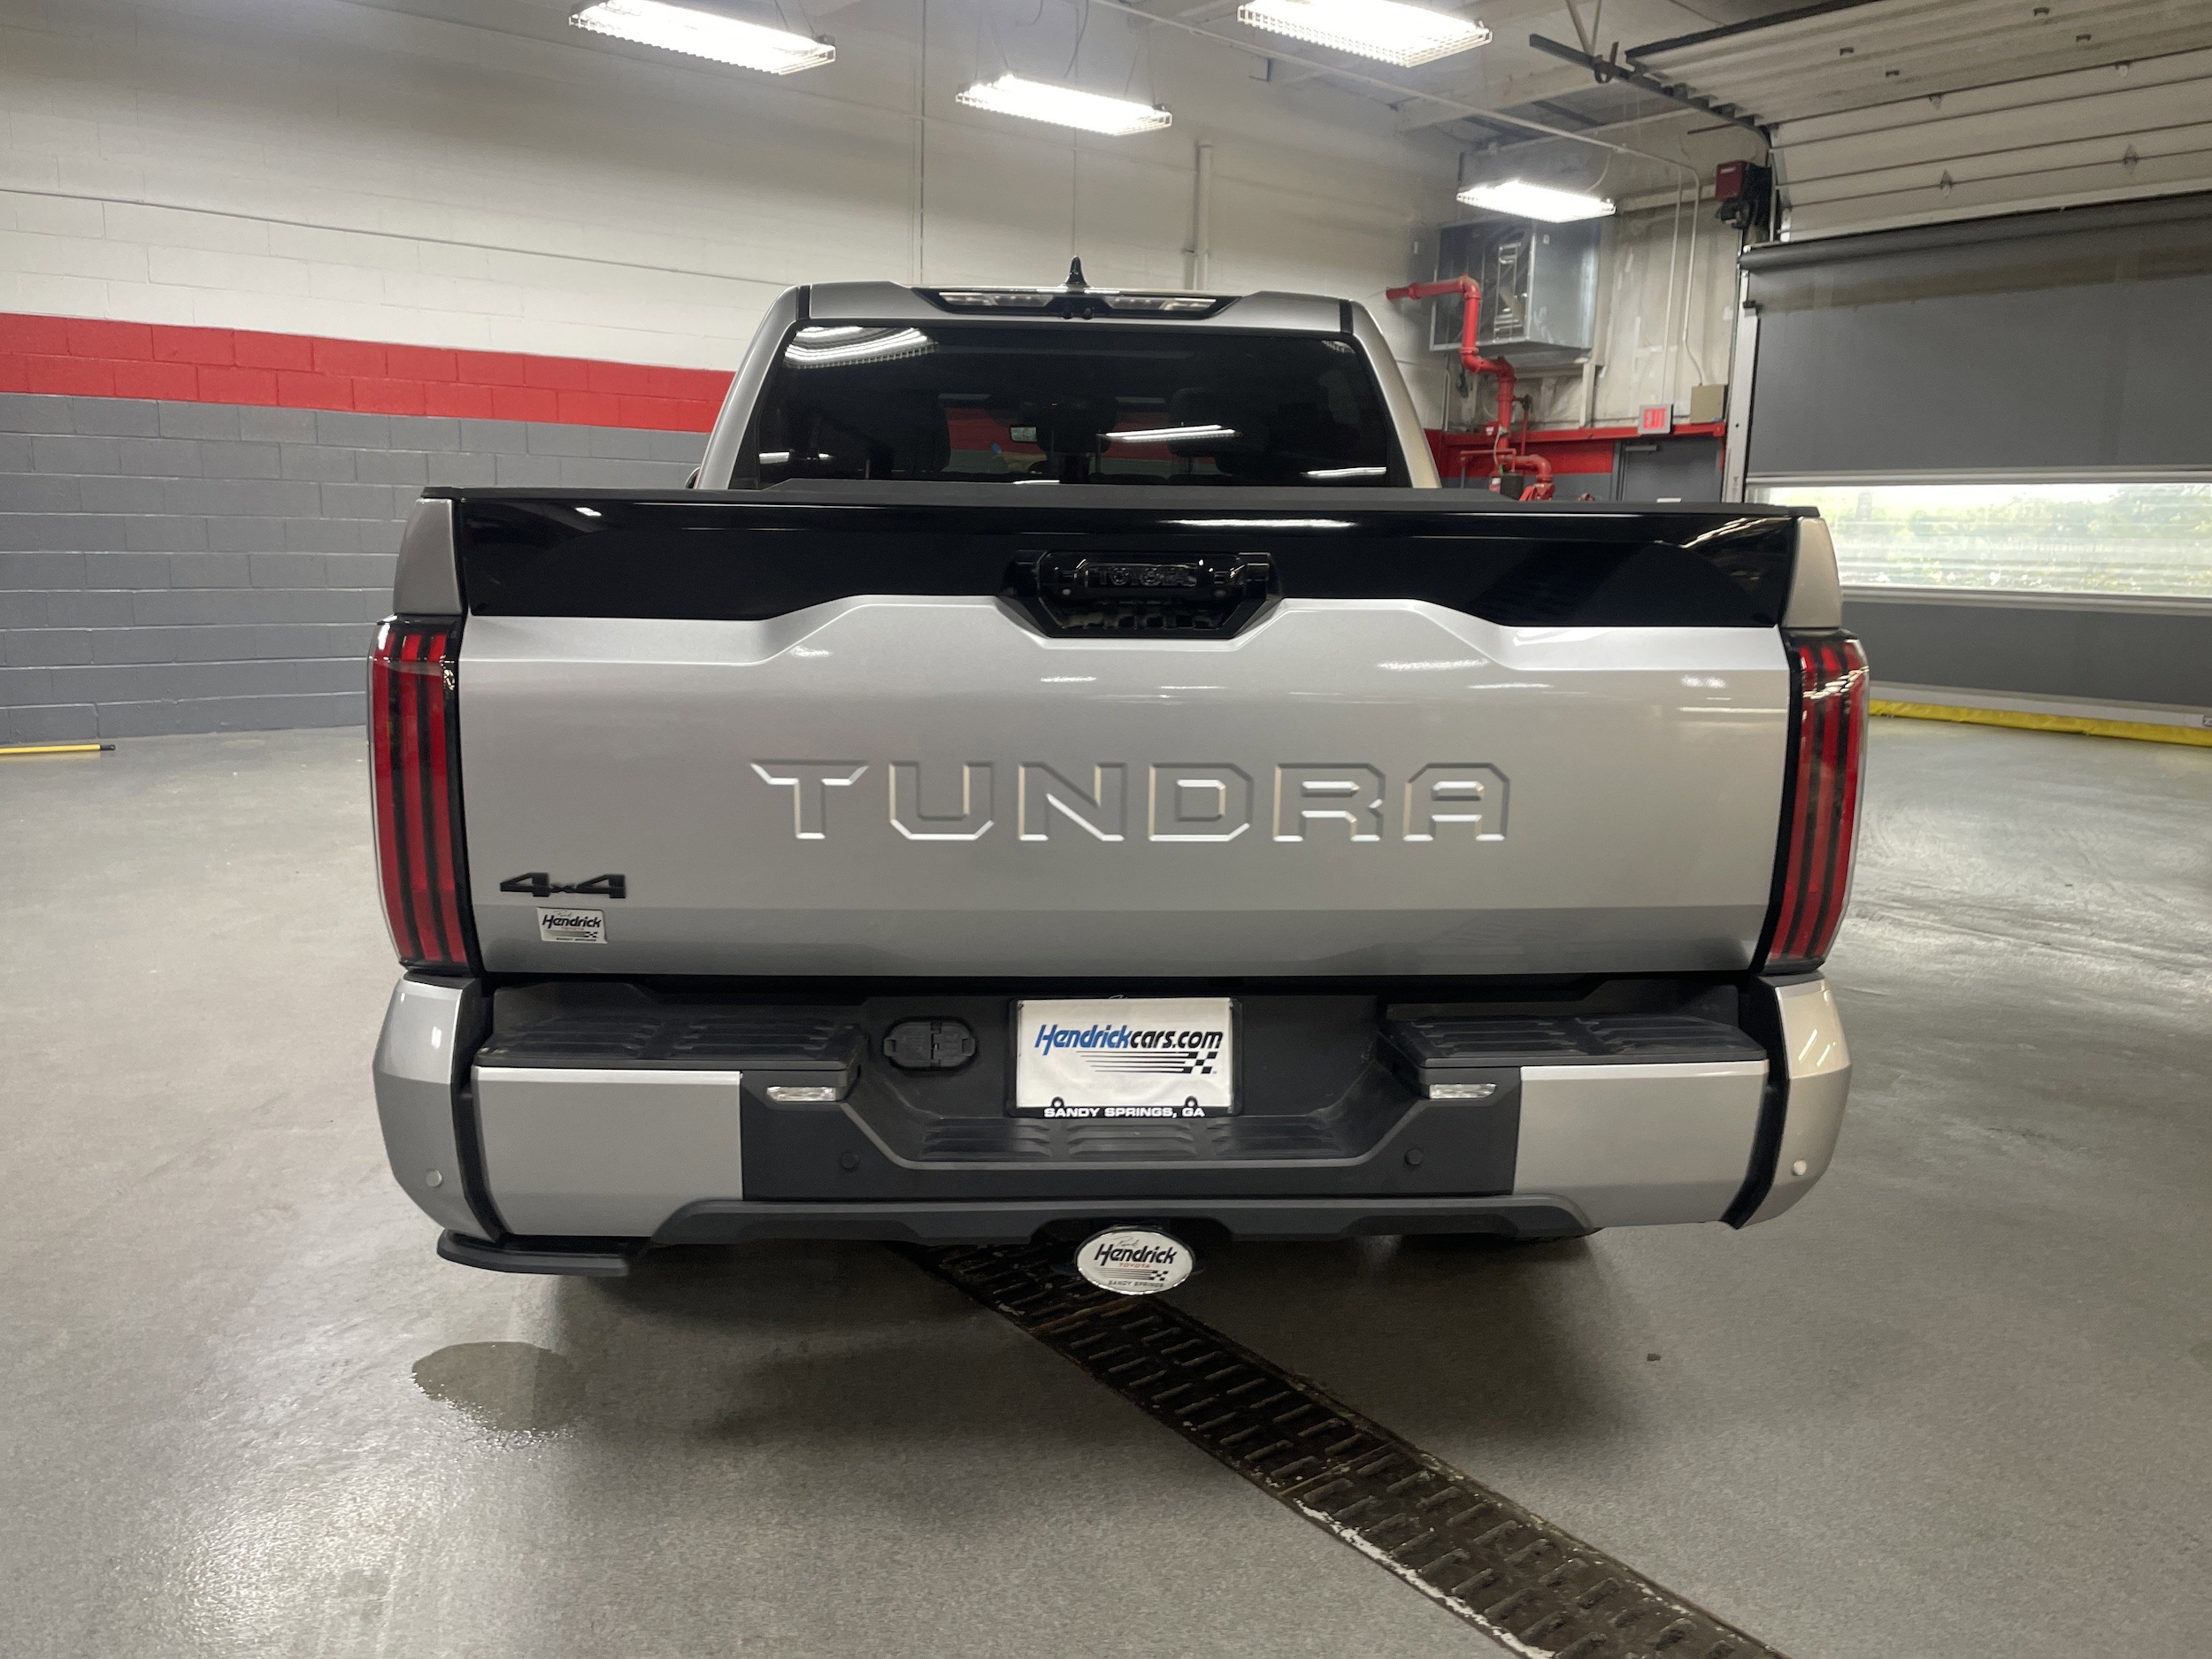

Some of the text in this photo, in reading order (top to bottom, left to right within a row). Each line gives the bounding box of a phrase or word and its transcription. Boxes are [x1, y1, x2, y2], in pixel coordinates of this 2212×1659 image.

[1643, 409, 1667, 430] EXIT
[749, 759, 1511, 842] TUNDRA
[541, 914, 602, 929] Hendrick
[1033, 1024, 1224, 1056] Hendrickcars.com
[1043, 1107, 1205, 1118] SANDY SPRINGS, GA
[1094, 1243, 1178, 1266] Hendrick
